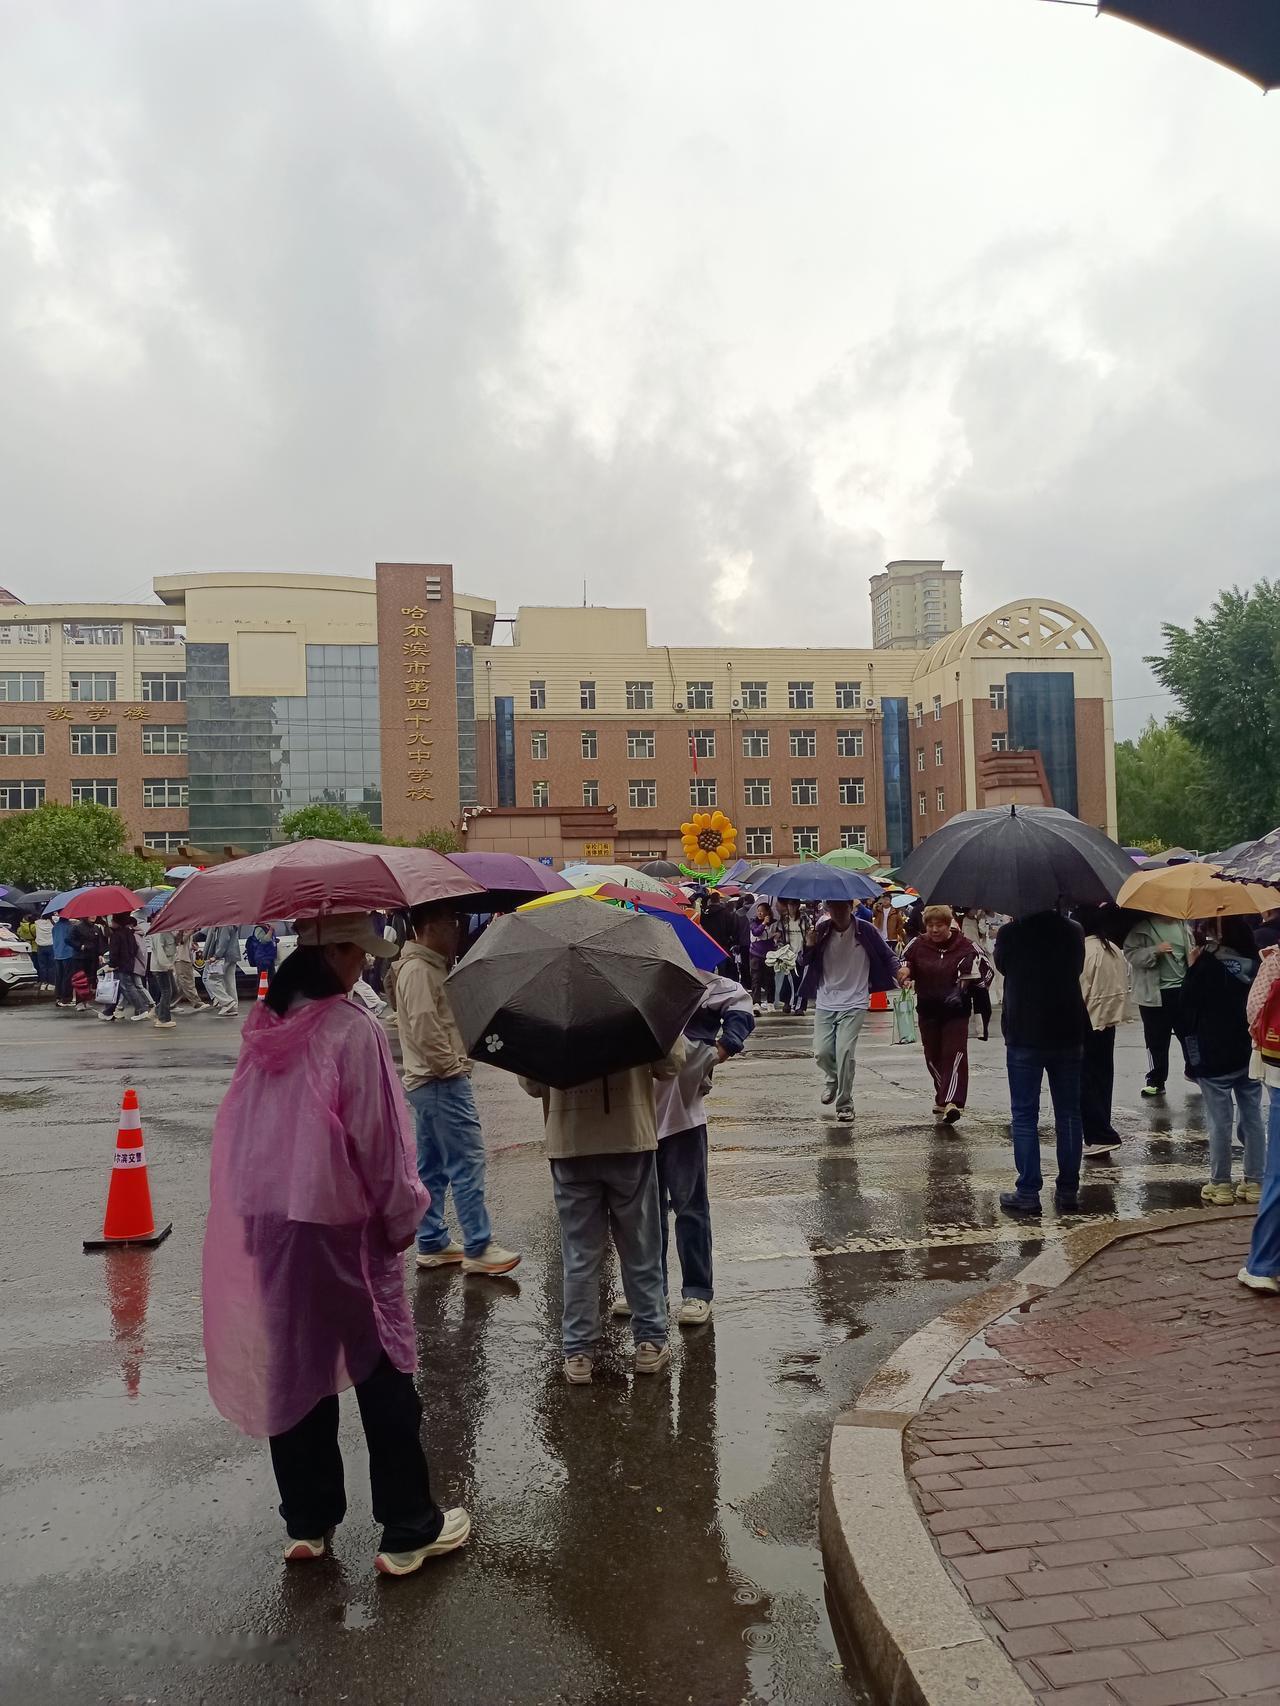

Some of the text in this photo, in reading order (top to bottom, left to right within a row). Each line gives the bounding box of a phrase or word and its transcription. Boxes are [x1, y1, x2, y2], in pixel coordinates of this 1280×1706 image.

[47, 705, 151, 721] 教学楼
[401, 605, 435, 801] 哈尔滨市第四十九中学校
